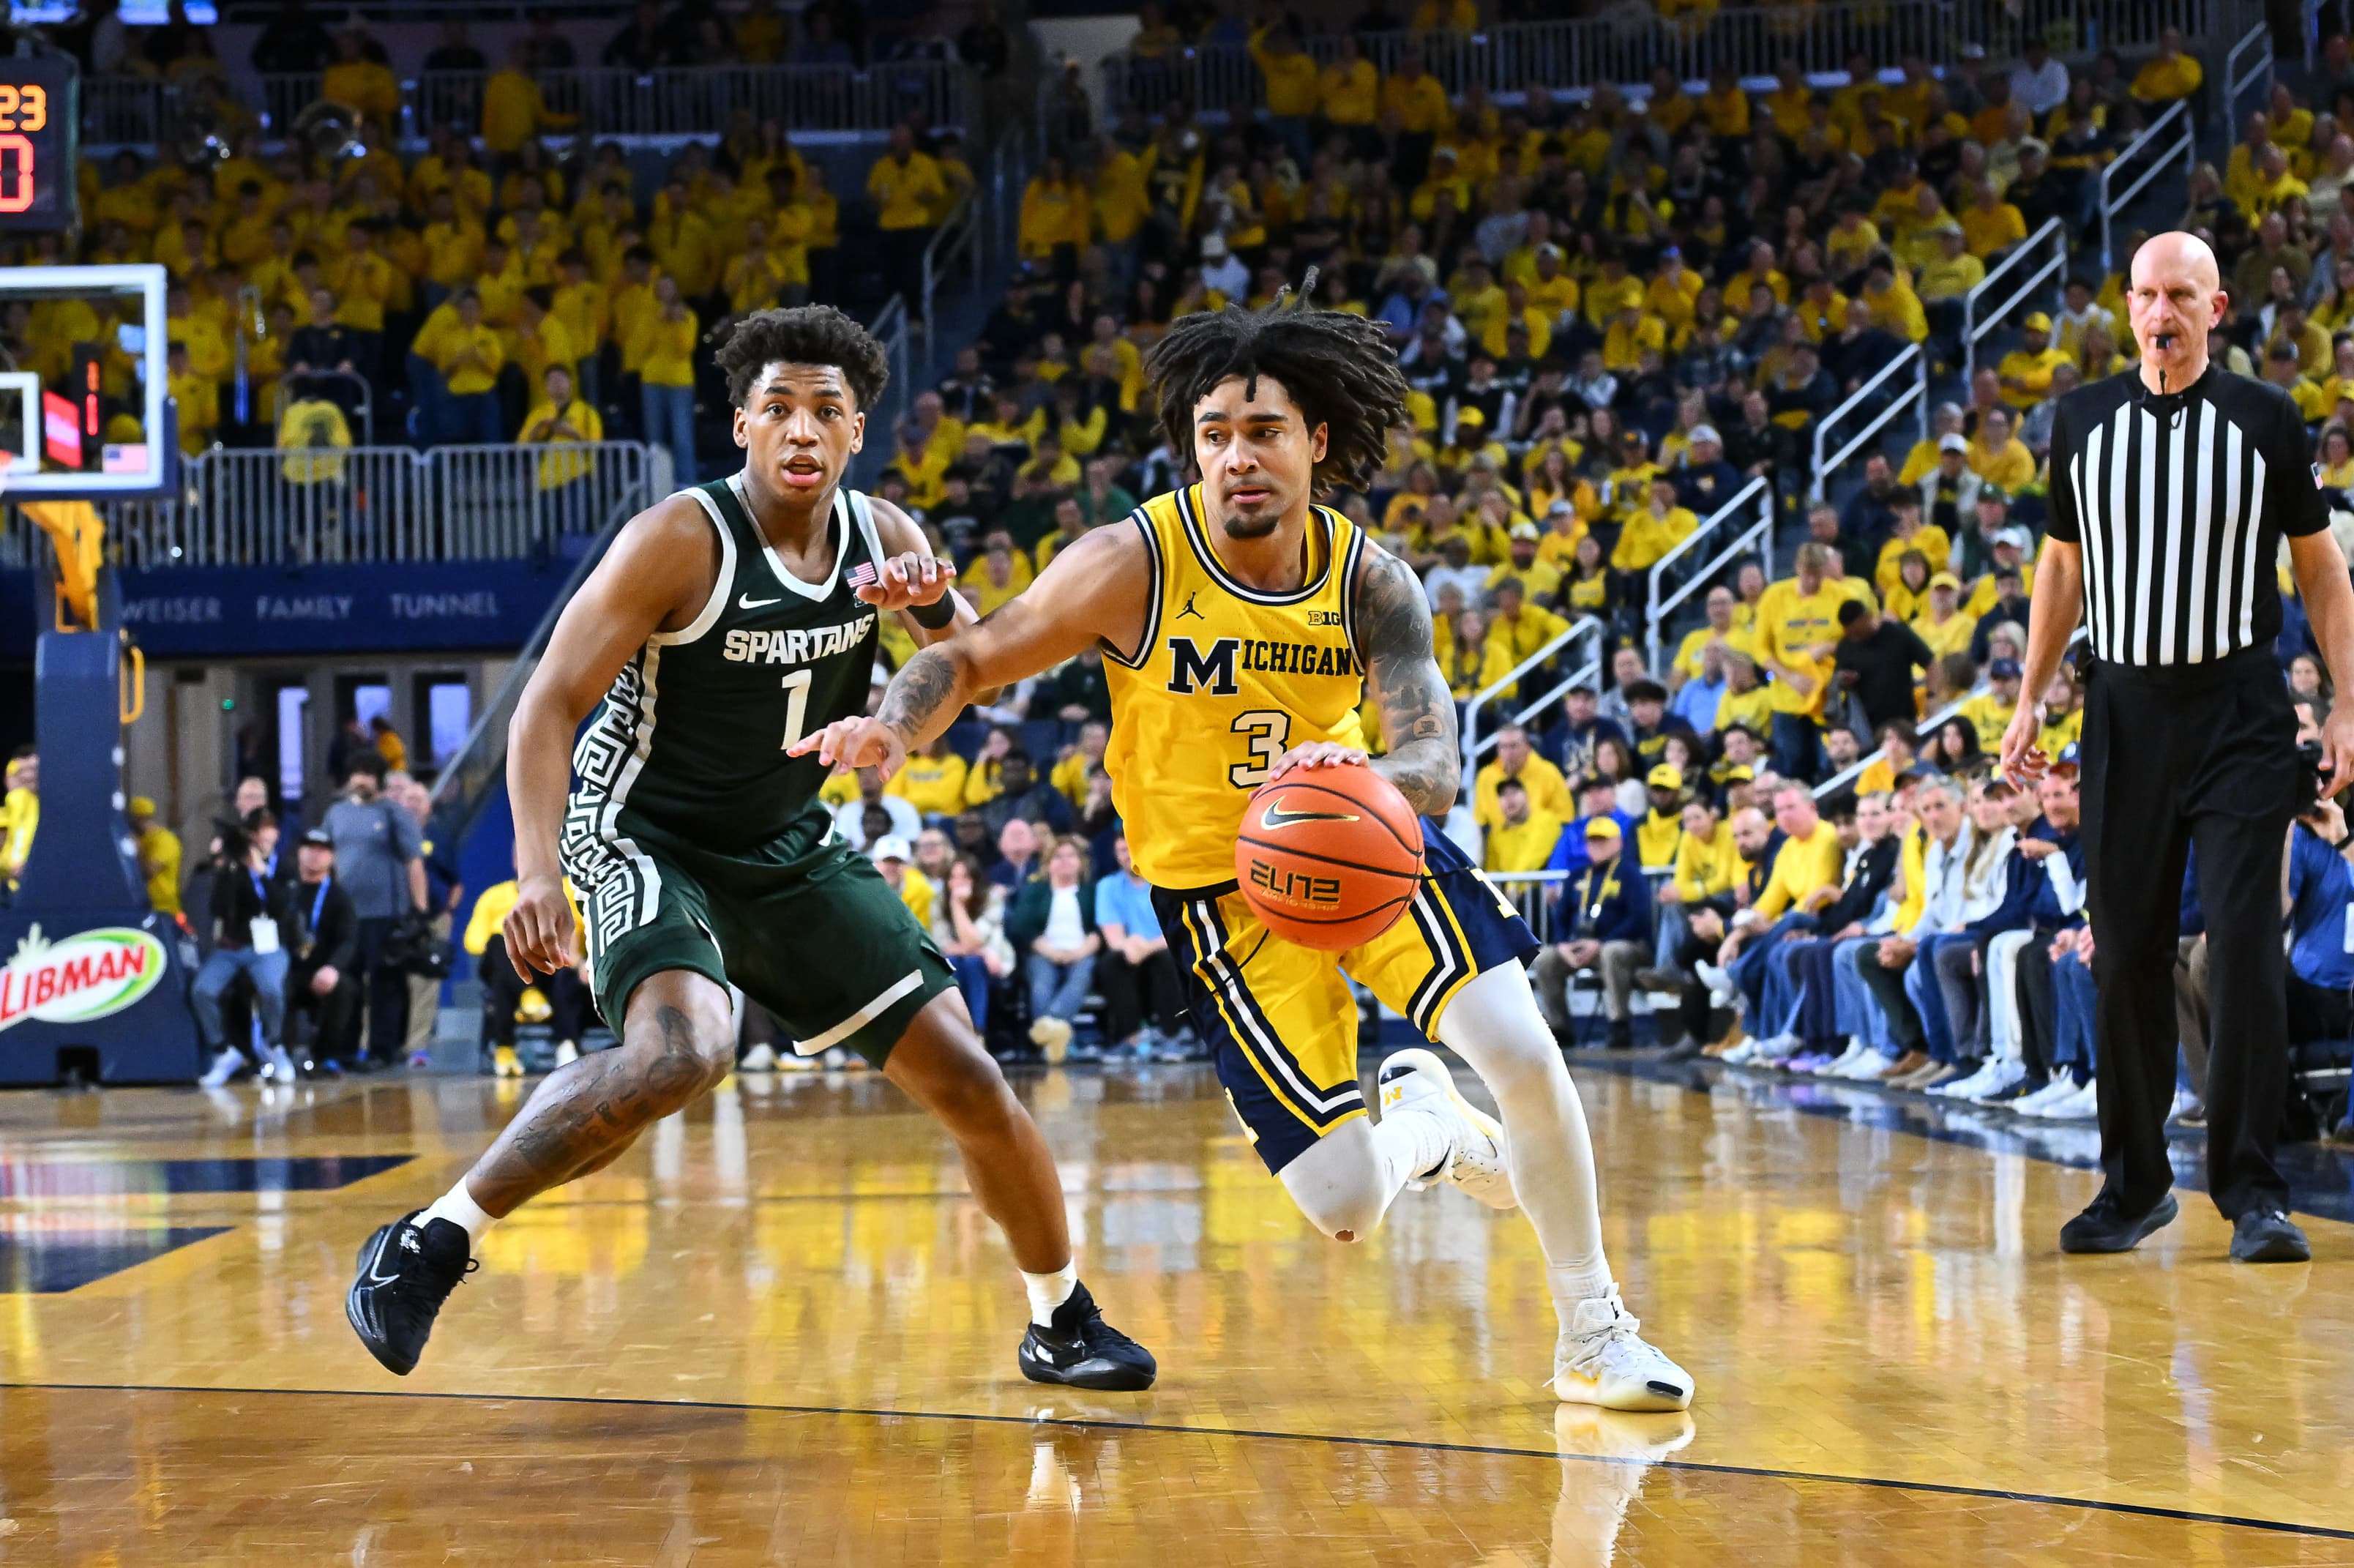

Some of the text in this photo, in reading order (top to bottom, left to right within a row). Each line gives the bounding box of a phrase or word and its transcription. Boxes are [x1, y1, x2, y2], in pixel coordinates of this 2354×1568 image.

[256, 594, 353, 621] FAMILY
[389, 592, 498, 619] TUNNEL
[723, 613, 875, 664] SPARTANS
[1167, 636, 1353, 695] MICHIGAN
[780, 669, 812, 750] 1
[1228, 709, 1291, 789] 3
[1250, 859, 1340, 903] ELITE
[0, 944, 146, 1022] LIBMAN
